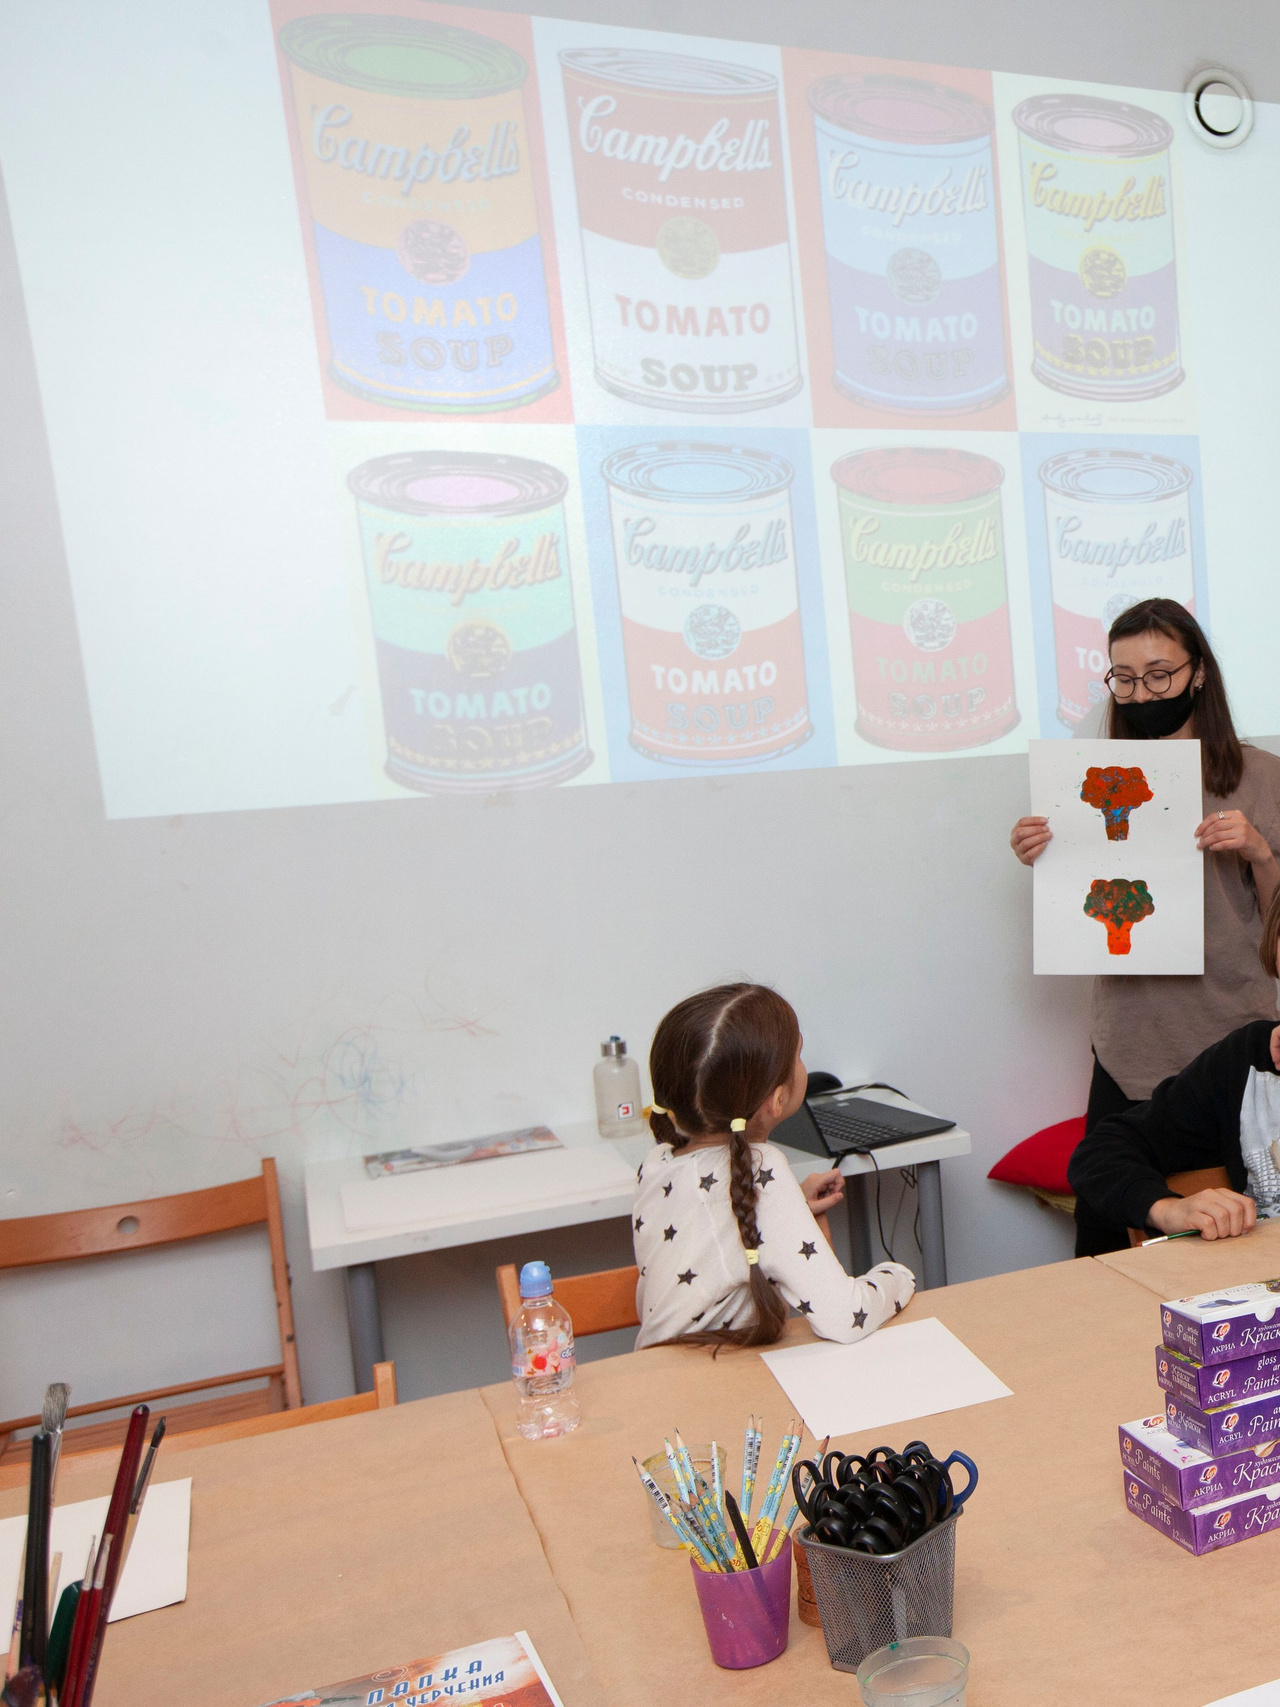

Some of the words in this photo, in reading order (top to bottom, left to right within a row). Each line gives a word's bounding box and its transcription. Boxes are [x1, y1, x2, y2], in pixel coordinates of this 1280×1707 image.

[622, 187, 745, 209] CONDENSED
[360, 285, 519, 328] TOMATO
[615, 293, 771, 337] TOMATO
[1050, 300, 1156, 333] TOMATO
[854, 306, 979, 343] TOMATO
[375, 330, 514, 372] SOUP
[867, 343, 974, 381] SOUP
[1061, 332, 1156, 369] SOUP
[641, 358, 759, 392] SOUP
[651, 660, 778, 696] TOMATO
[876, 652, 988, 684] TOMATO
[410, 682, 552, 721] TOMATO
[666, 697, 776, 733] SOUP
[889, 687, 986, 720] SOUP
[1210, 1342, 1236, 1355] АКРИЛ
[1256, 1354, 1277, 1371] gloss
[1207, 1389, 1237, 1404] ACRYL
[1242, 1374, 1280, 1394] Paints
[1218, 1431, 1244, 1445] ACRYL
[1135, 1448, 1161, 1481] Paints
[1193, 1482, 1223, 1498] АКРИЛ
[1142, 1493, 1172, 1526] Paints
[1207, 1527, 1236, 1544] АКРИЛ
[367, 1660, 483, 1706] ПАПКА
[406, 1670, 505, 1707] ЧЕРЧЕНИЯ
